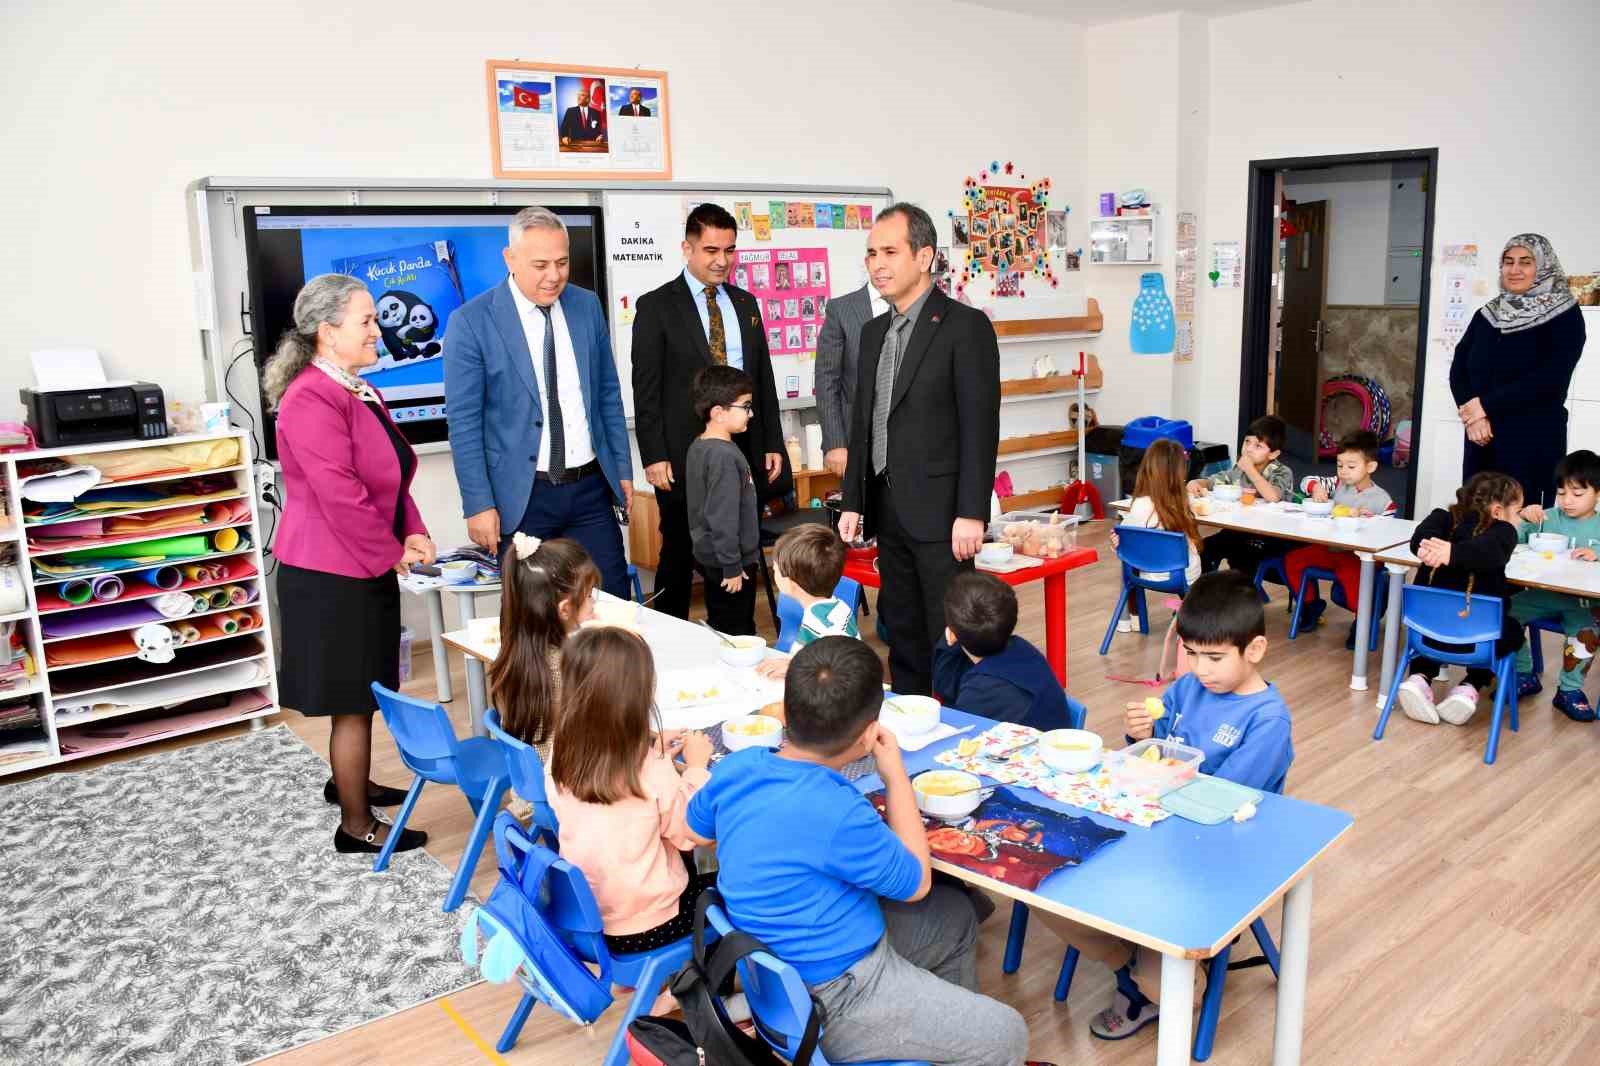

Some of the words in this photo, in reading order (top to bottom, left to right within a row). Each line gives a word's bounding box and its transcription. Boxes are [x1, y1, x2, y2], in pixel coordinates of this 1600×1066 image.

[634, 221, 641, 229] 5
[620, 237, 655, 245] DAKİKA
[612, 253, 664, 262] MATEMATİK
[620, 296, 629, 309] 1
